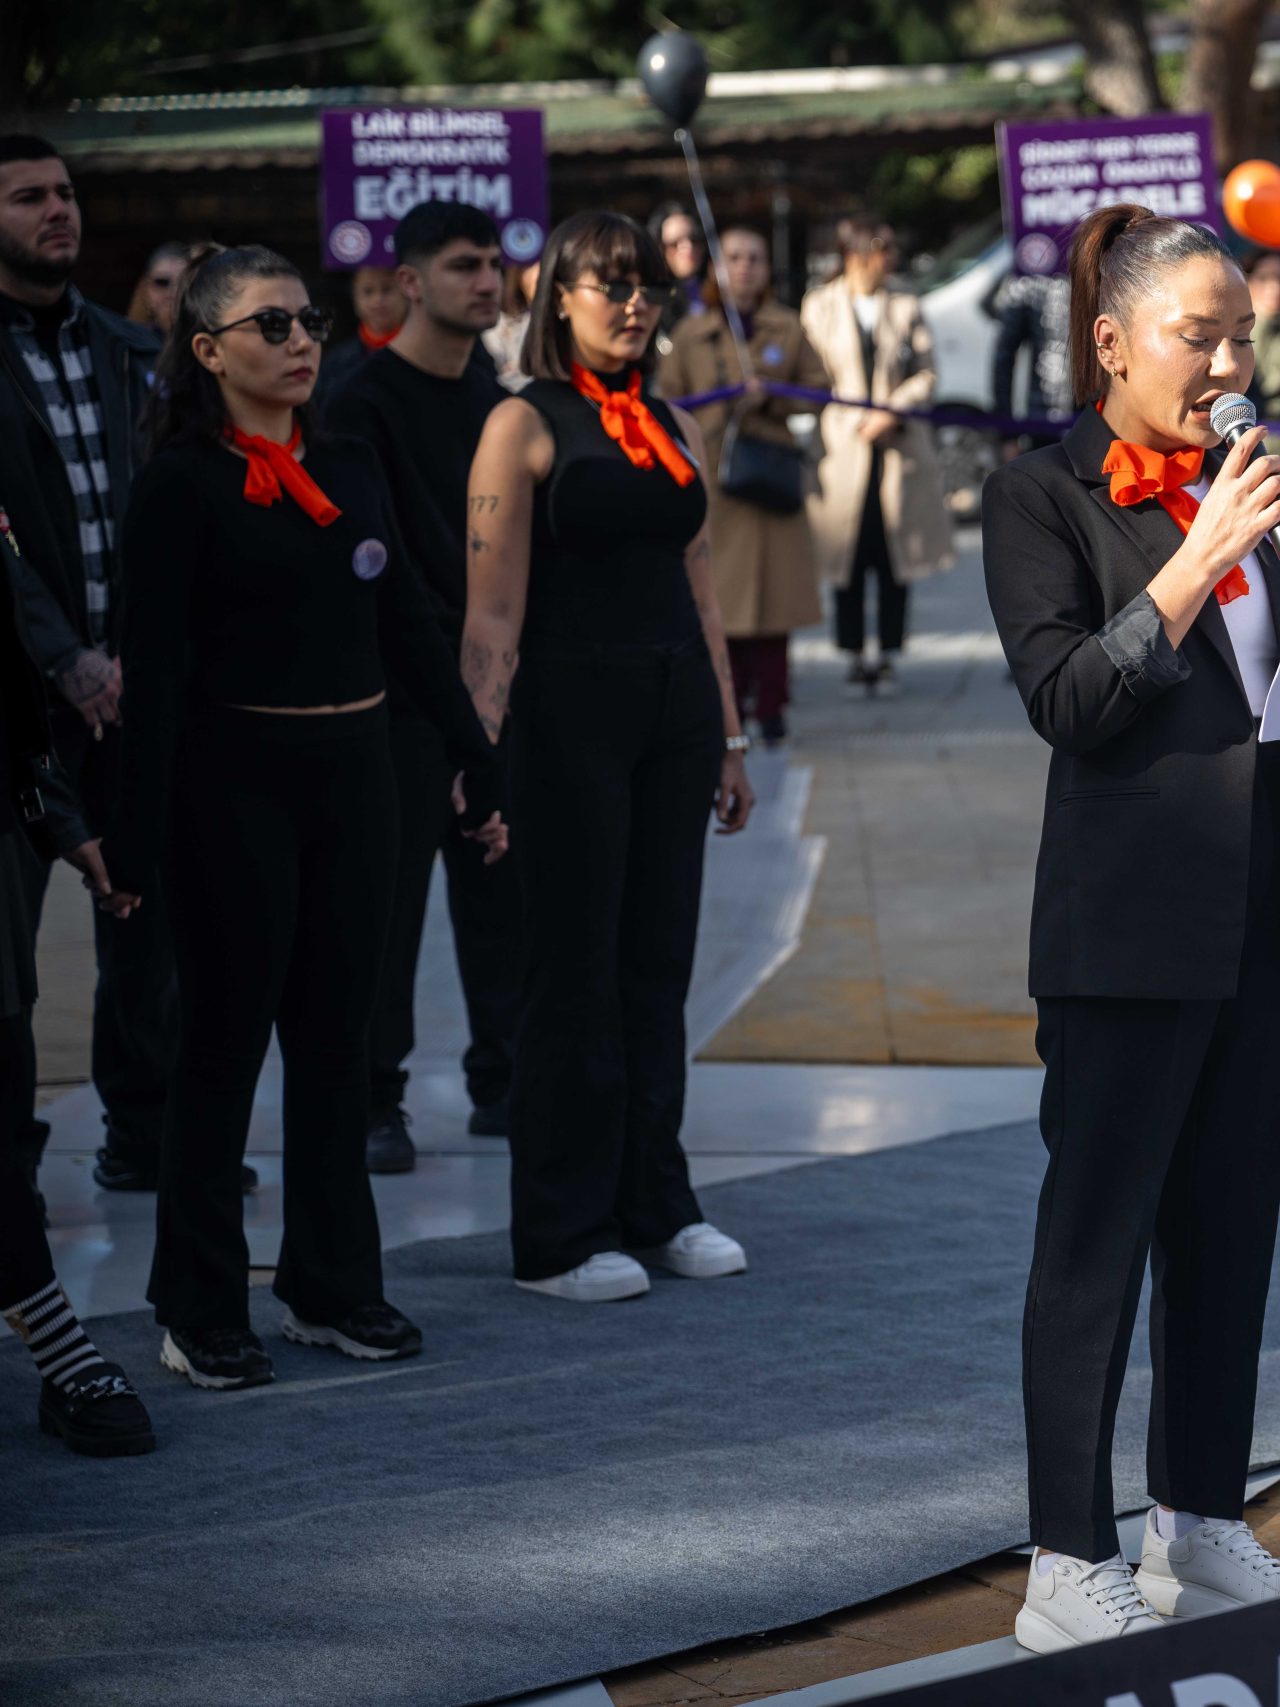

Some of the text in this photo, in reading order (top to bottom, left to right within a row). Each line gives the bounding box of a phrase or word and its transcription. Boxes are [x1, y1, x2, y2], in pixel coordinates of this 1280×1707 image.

[352, 108, 510, 138] LAİK BİLİMSEL
[354, 166, 512, 220] EĞİTİM
